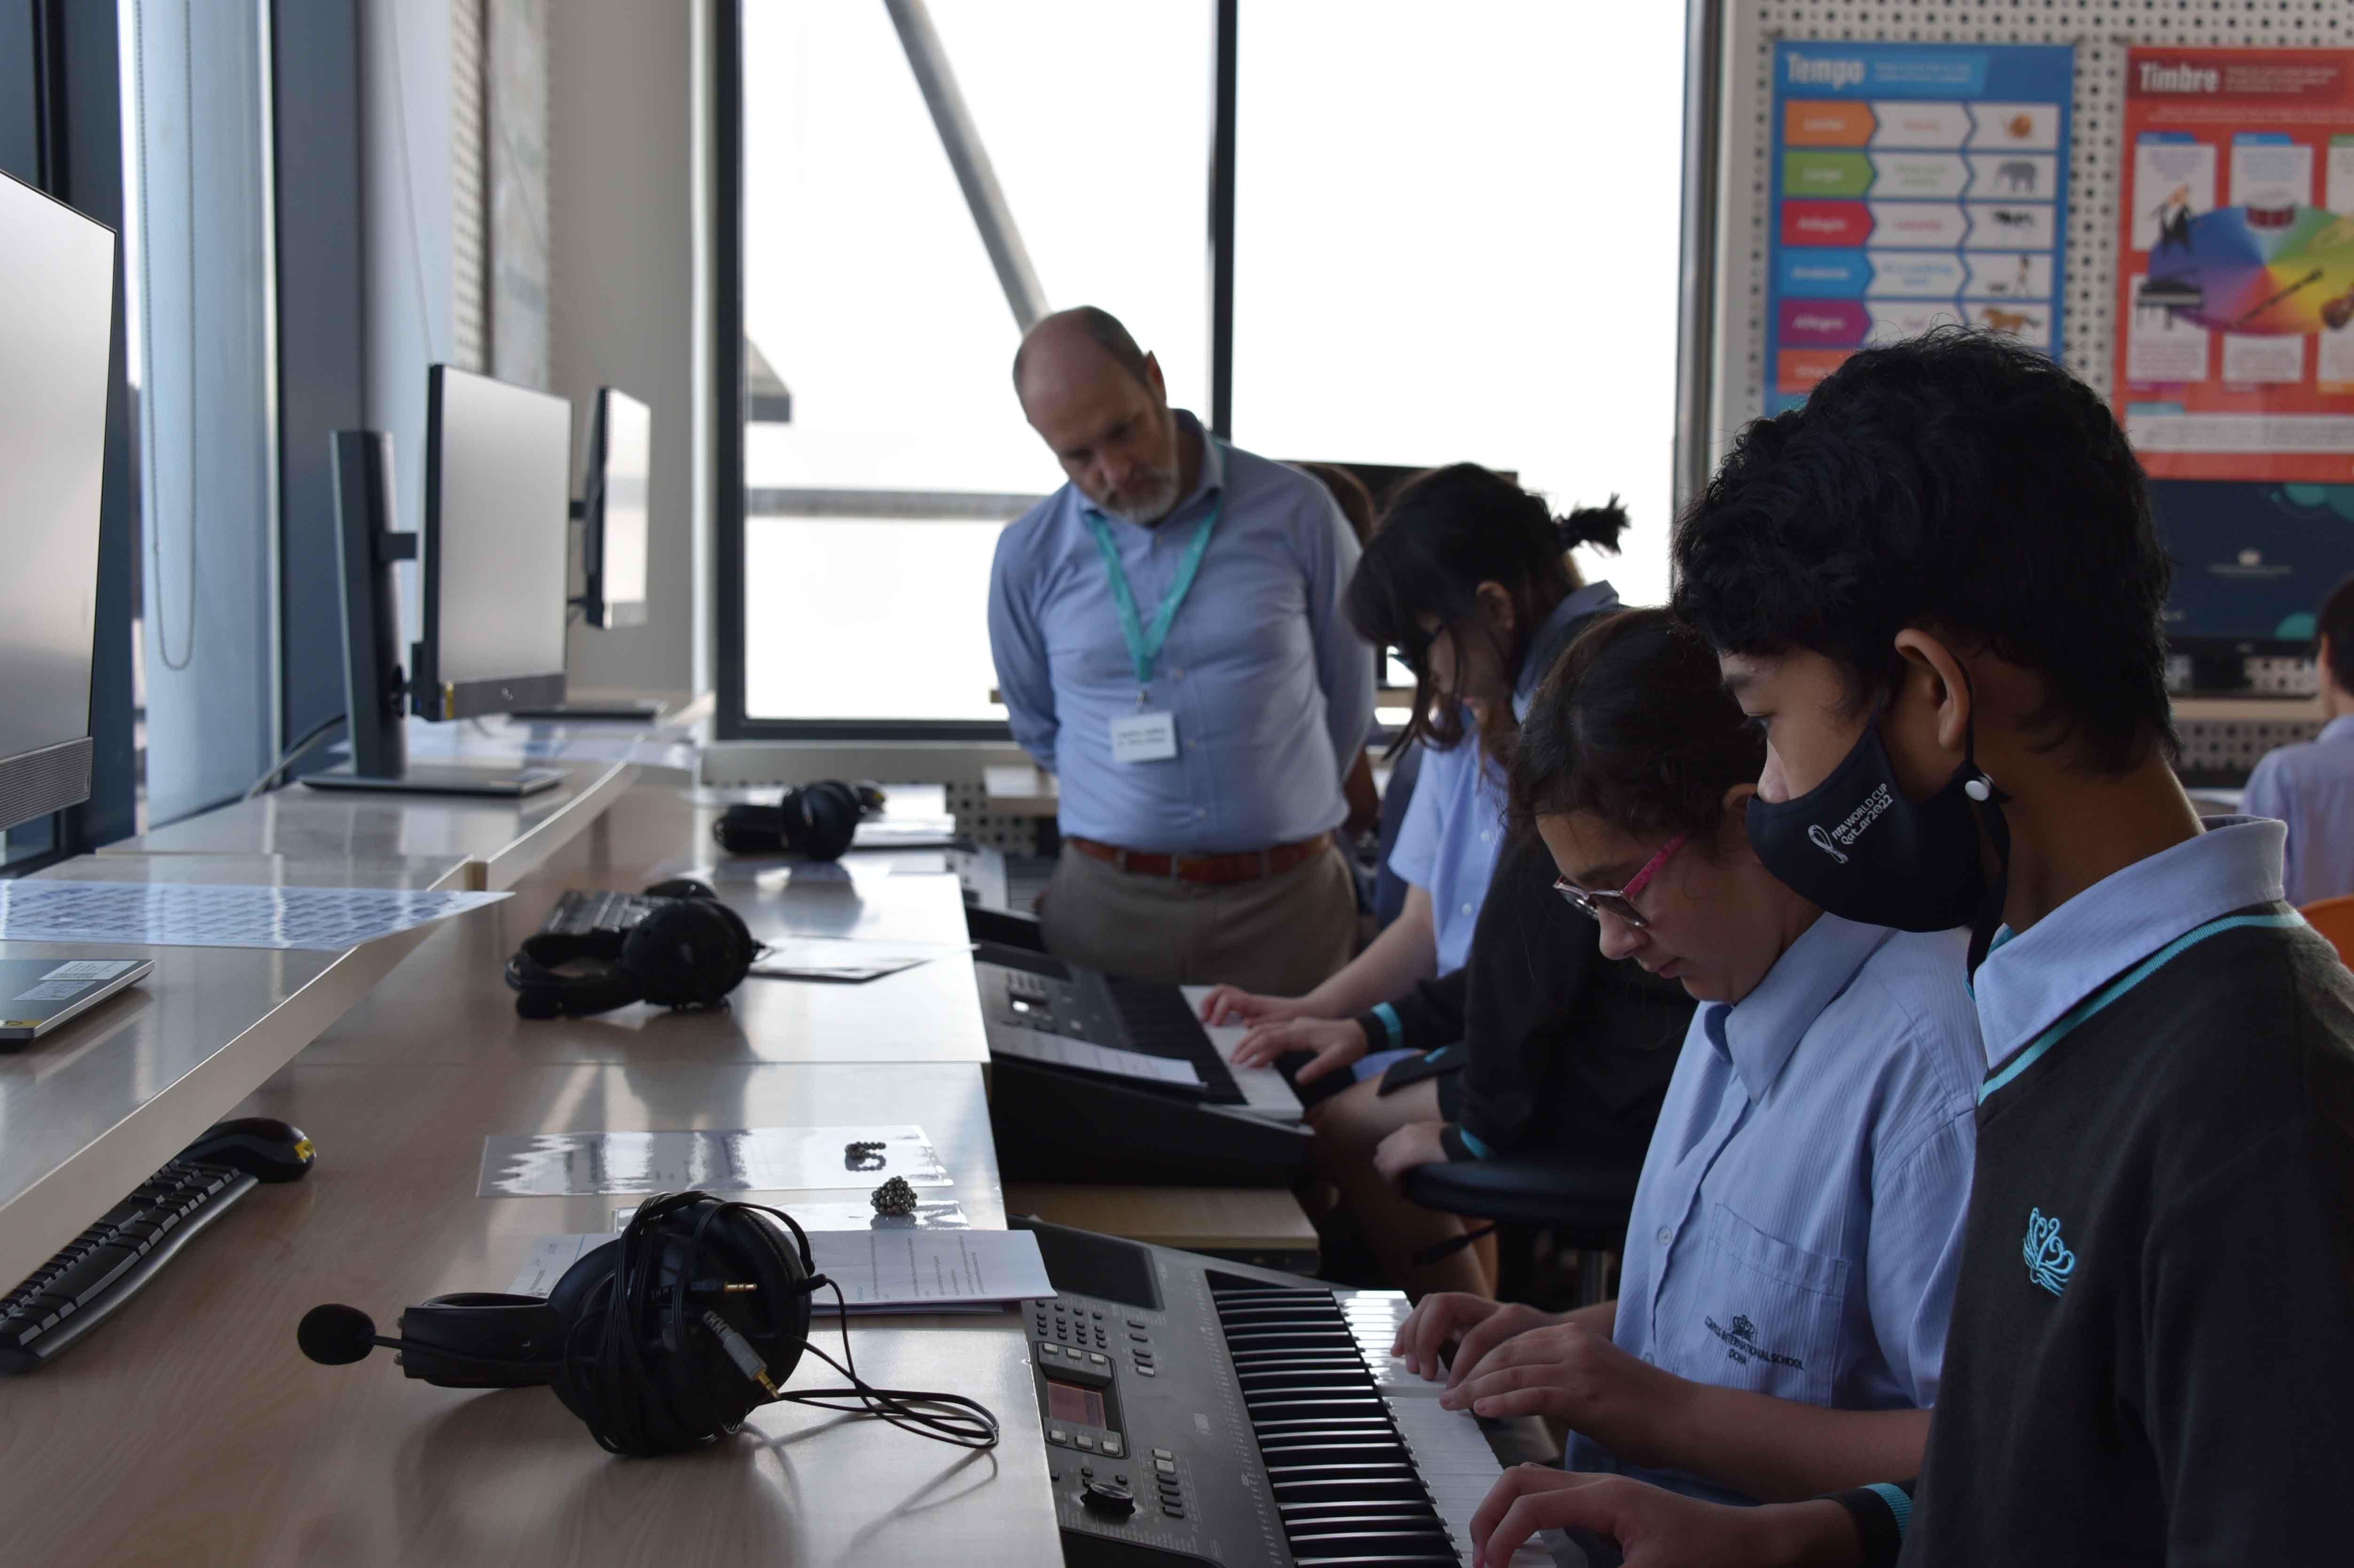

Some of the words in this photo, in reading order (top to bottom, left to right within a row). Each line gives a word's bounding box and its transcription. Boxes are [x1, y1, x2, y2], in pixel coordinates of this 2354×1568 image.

[1785, 53, 1865, 89] Tempo
[2139, 60, 2219, 93] Timbre
[1831, 824, 1849, 840] FIFA
[1844, 798, 1874, 825] WORLD
[1872, 784, 1887, 800] CUP
